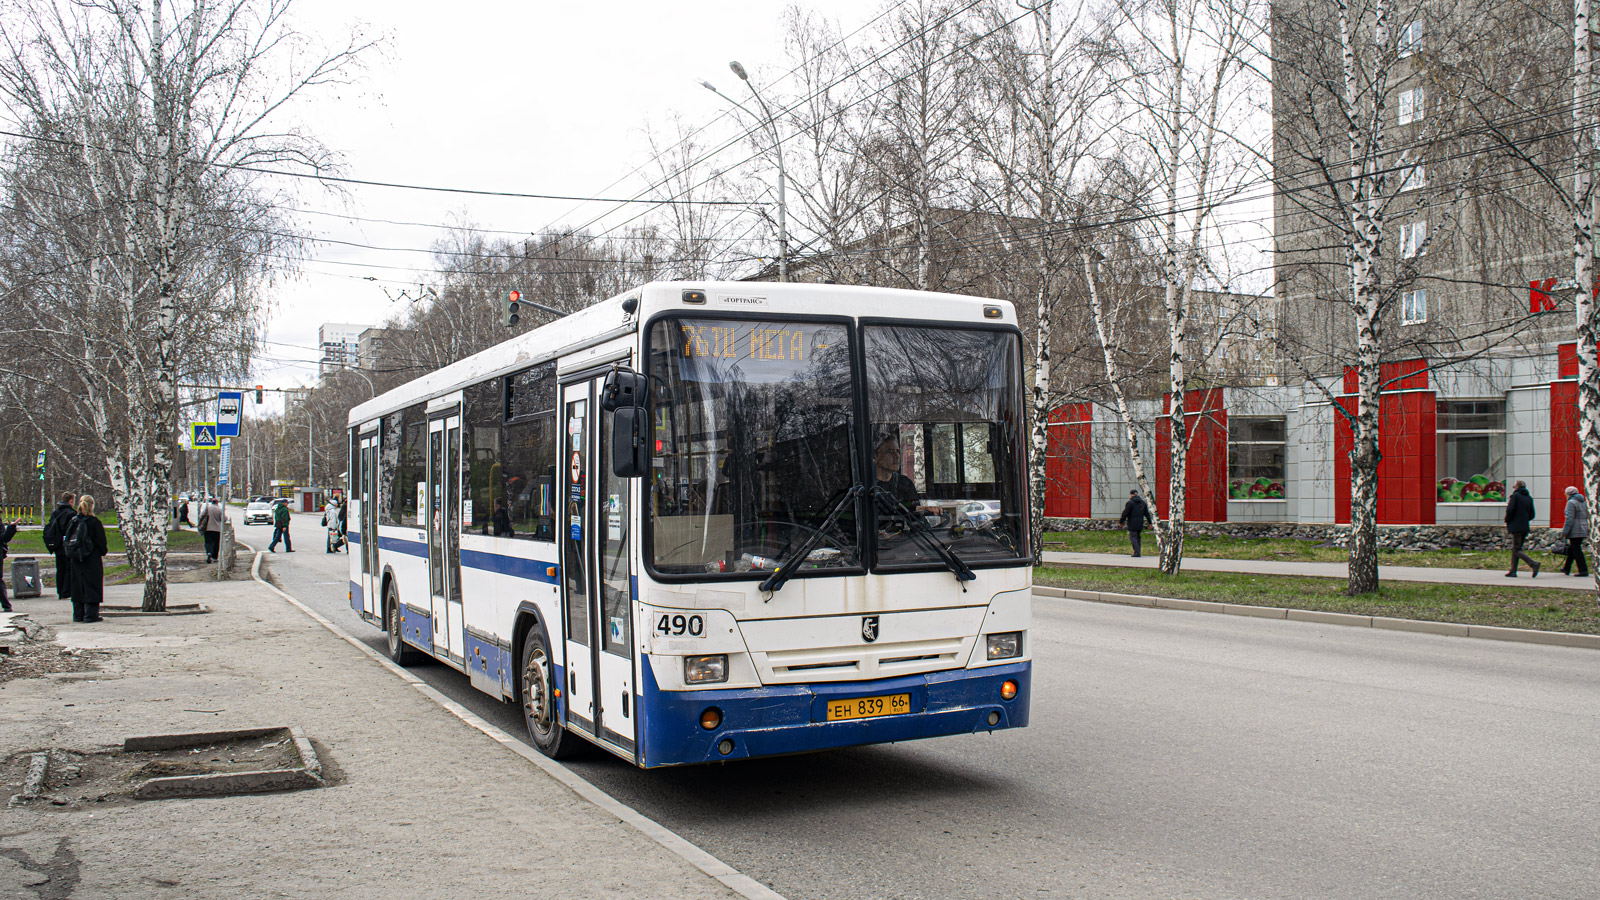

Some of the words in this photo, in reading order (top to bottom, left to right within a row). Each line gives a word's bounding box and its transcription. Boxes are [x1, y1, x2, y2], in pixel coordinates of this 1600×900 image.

[750, 329, 803, 360] МЕГА
[657, 614, 704, 637] 490
[835, 705, 852, 717] ЕН
[858, 699, 883, 714] 839
[892, 696, 904, 707] 66
